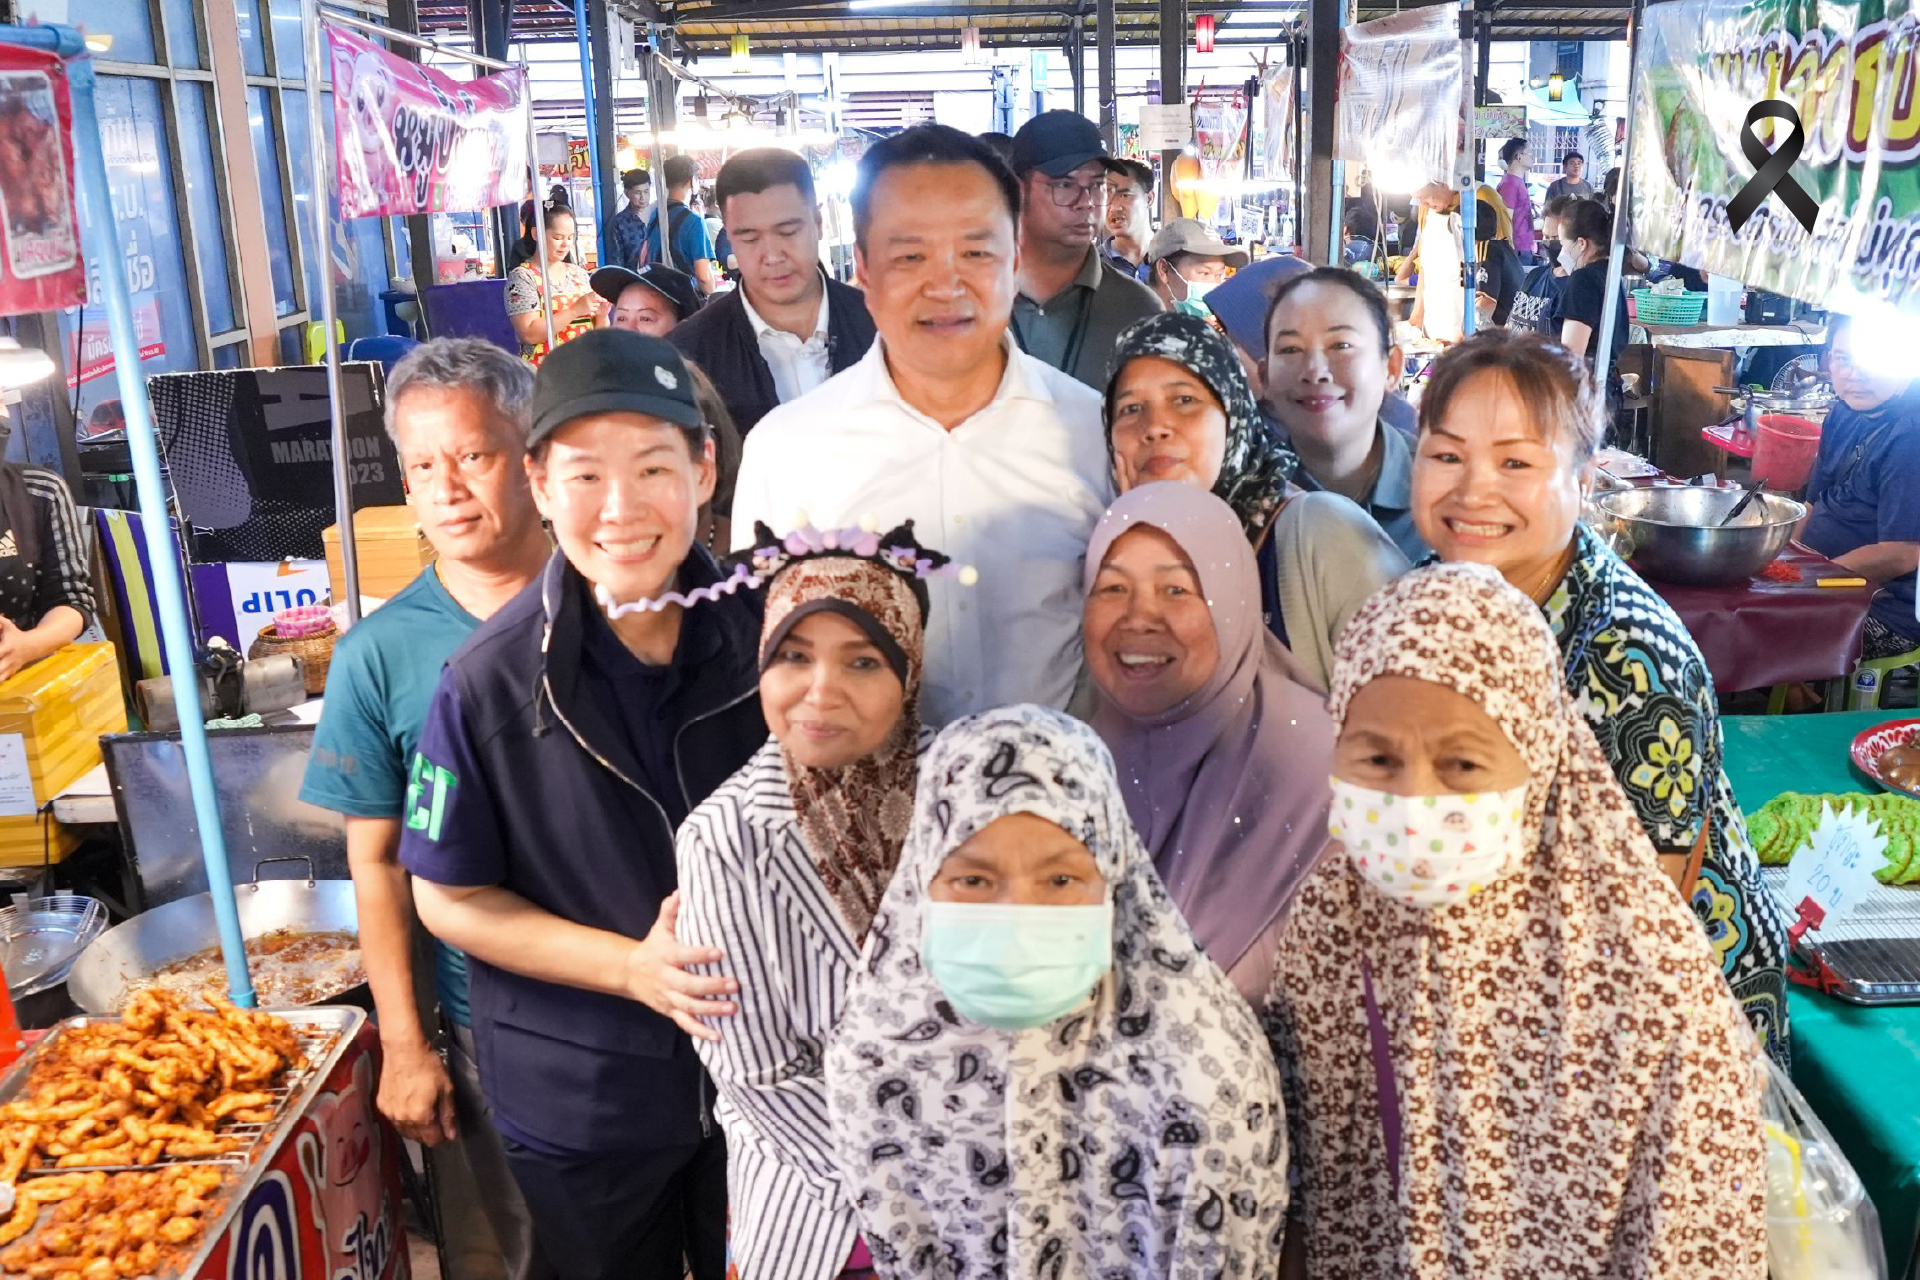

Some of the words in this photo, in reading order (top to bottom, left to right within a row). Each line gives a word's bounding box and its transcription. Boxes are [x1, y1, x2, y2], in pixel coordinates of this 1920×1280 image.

[270, 436, 381, 464] MARAON
[241, 587, 331, 613] ULIP
[1806, 863, 1831, 893] 20
